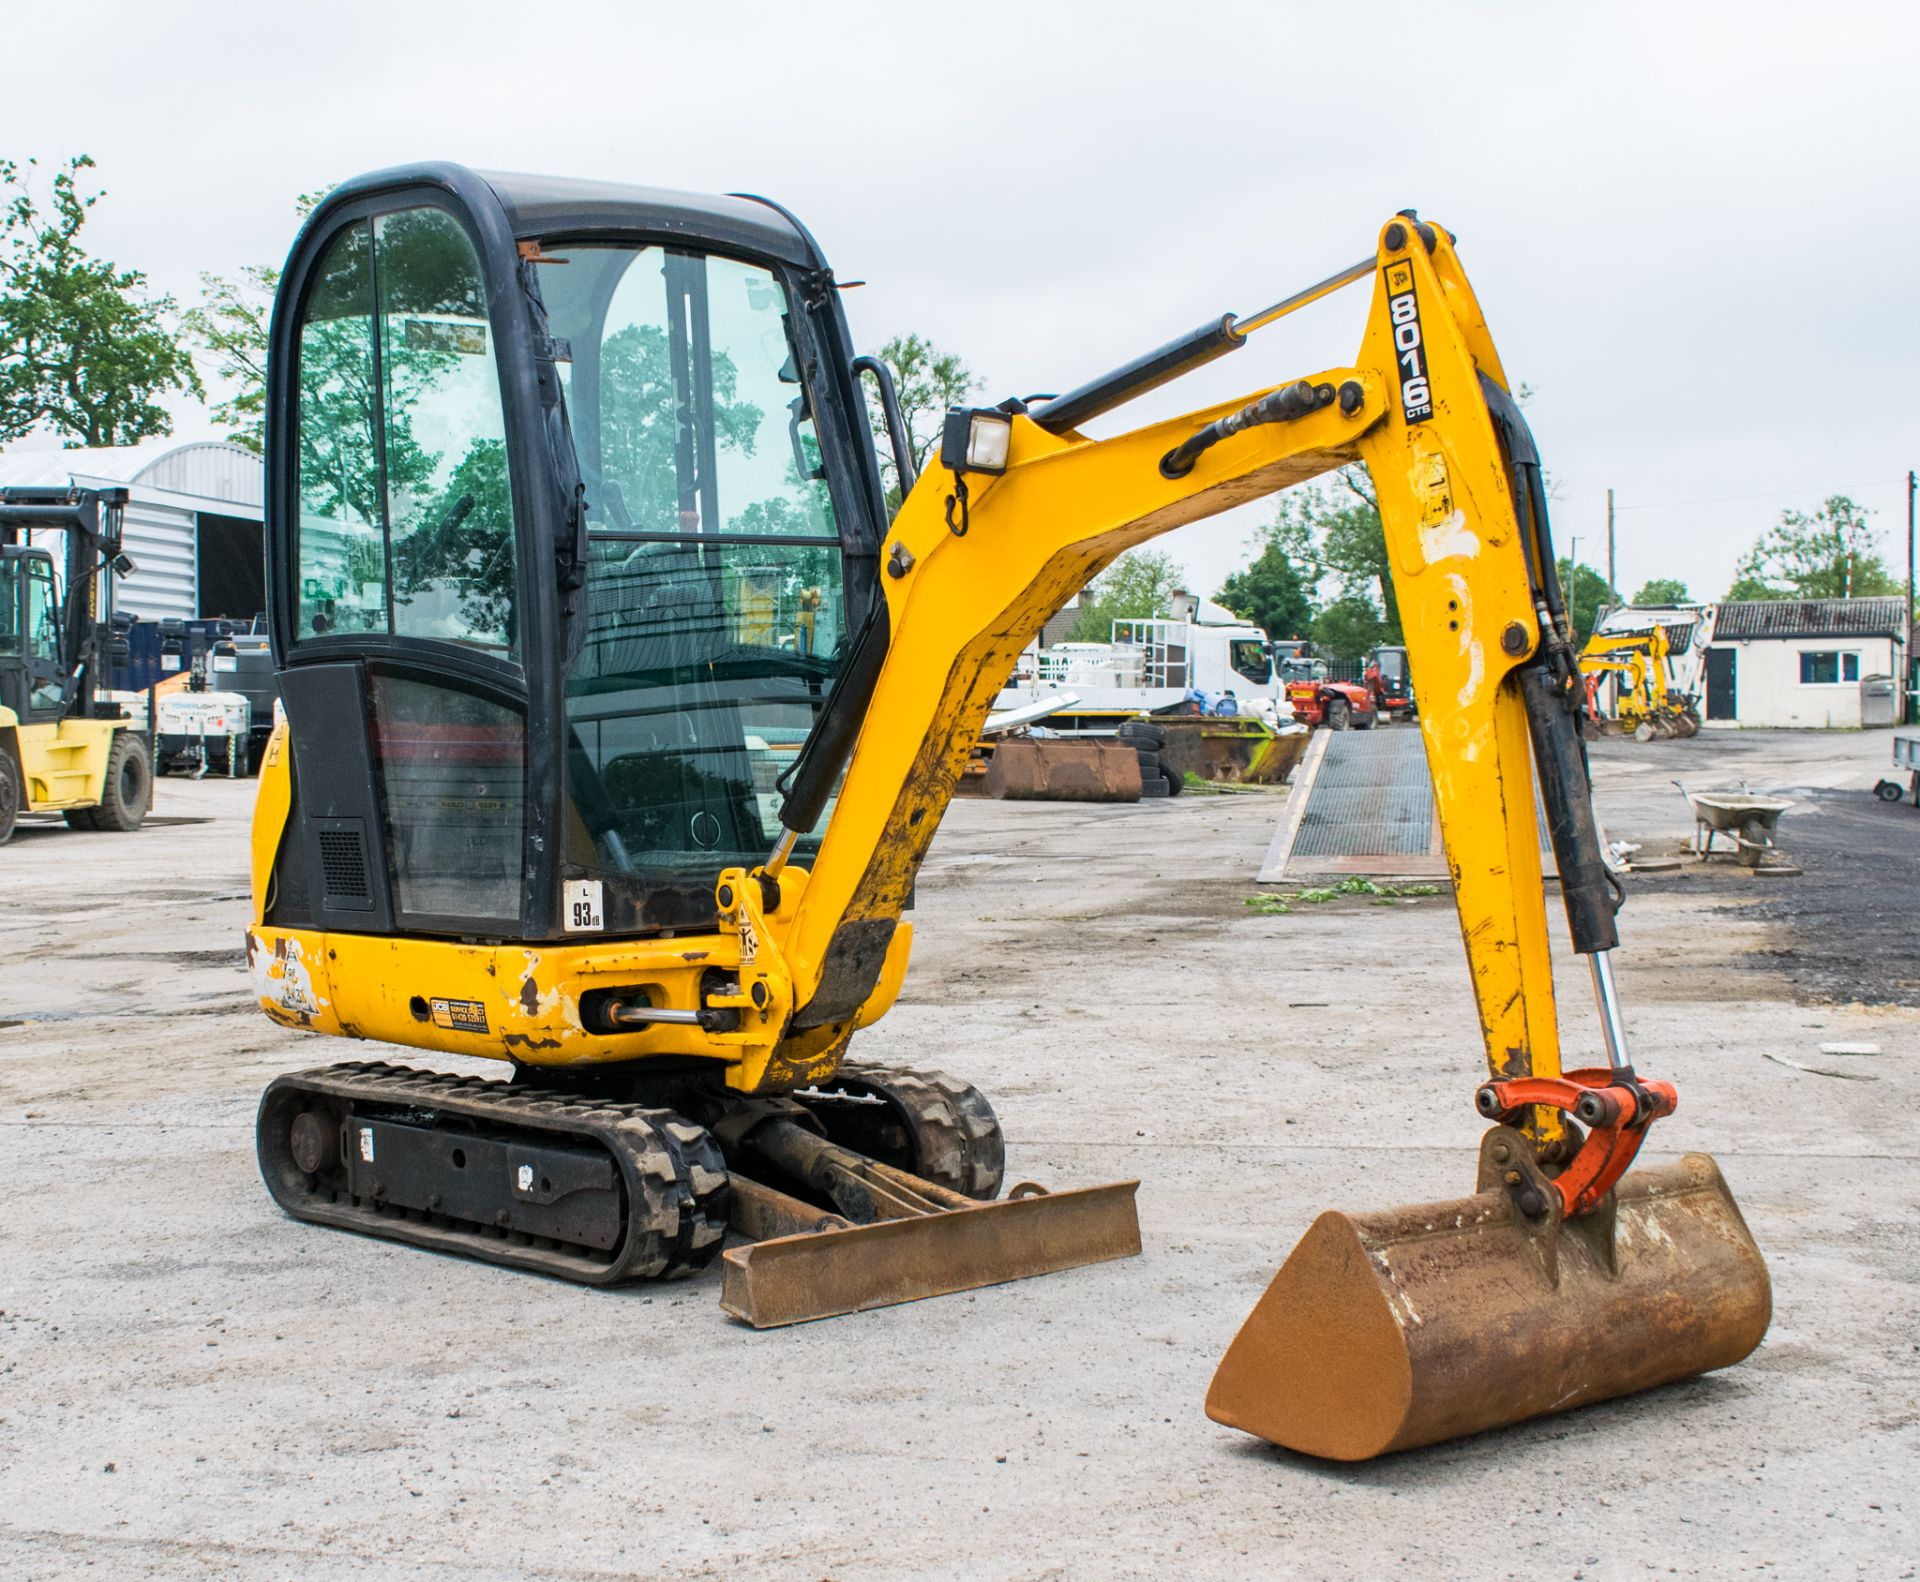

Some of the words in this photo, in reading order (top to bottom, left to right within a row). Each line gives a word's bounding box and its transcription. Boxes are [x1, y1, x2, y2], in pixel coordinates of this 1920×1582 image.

[1390, 294, 1430, 409] 8016
[1406, 404, 1431, 419] CTS
[582, 888, 589, 897] L
[573, 902, 591, 927] 93
